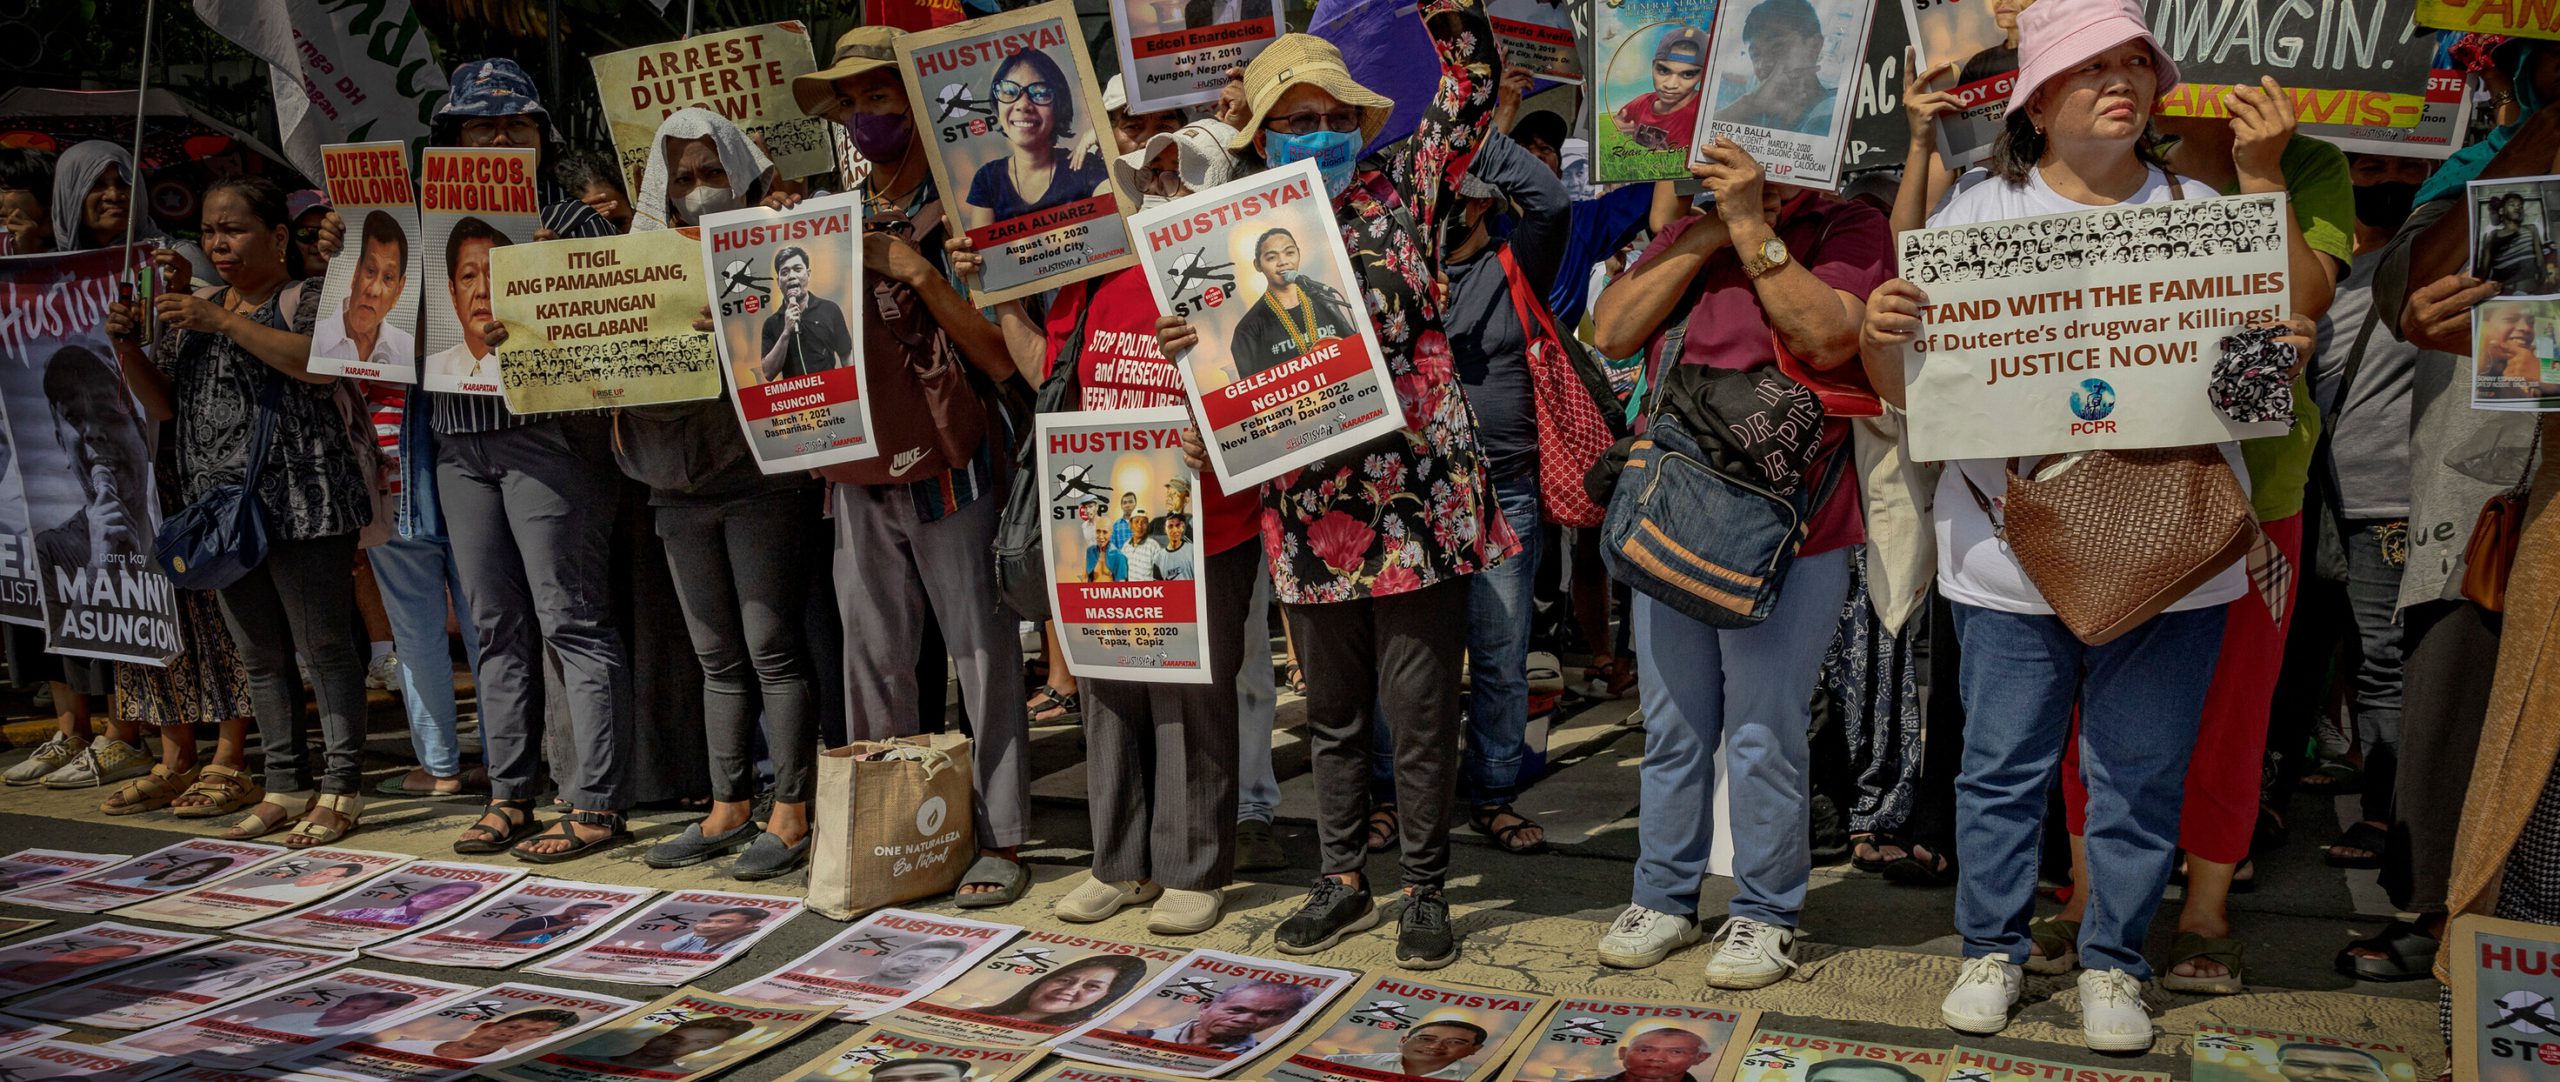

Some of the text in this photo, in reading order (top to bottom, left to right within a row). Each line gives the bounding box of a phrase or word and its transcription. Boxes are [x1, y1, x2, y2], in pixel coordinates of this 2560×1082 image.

[916, 24, 1065, 77] HUSTISYA!
[1146, 24, 1264, 52] Edcel Enardecido
[637, 34, 764, 81] ARREST
[1175, 47, 1242, 66] July 27, 2019
[631, 61, 785, 110] DUTERTE
[1146, 63, 1233, 84] Ayungon, Negros
[335, 76, 368, 107] DH
[1712, 121, 1733, 132] RICO
[1744, 127, 1772, 138] BALLA
[2406, 135, 2448, 144] KARAPATAN
[1767, 148, 1791, 159] BAGONG
[1768, 140, 1788, 149] MARCH
[1798, 144, 1811, 152] 2020
[427, 157, 532, 188] MARCOS,
[1775, 163, 1793, 175] UP
[1794, 161, 1826, 172] CALOOCAN
[329, 176, 414, 205] IKULONG!
[424, 183, 537, 212] SINGILIN!
[987, 202, 1097, 242] ZARA ALVAREZ
[1149, 179, 1311, 253] HUSTISYA!
[713, 213, 850, 252] HUSTISYA!
[1005, 225, 1089, 256] August 17, 2020
[568, 249, 621, 269] ITIGIL
[1019, 241, 1085, 266] Bacolod City
[506, 263, 687, 297] ANG PAMAMASLANG,
[536, 293, 656, 320] KATARUNGAN
[2007, 289, 2082, 317] WITH
[2089, 284, 2142, 308] THE
[2149, 272, 2284, 303] FAMILIES
[547, 316, 649, 341] IPAGLABAN!
[1089, 329, 1116, 352] STOP
[1914, 334, 1937, 353] of
[2064, 317, 2170, 341] drugwar
[2178, 304, 2280, 330] Killings!
[345, 366, 380, 378] KARAPATAN
[1095, 358, 1116, 383] and
[1224, 344, 1341, 400] GELEJURAINE
[1987, 341, 2198, 385] JUSTICE NOW!
[463, 383, 498, 393] KARAPATAN
[613, 388, 625, 397] UP
[764, 375, 825, 396] EMMANUEL
[1251, 372, 1327, 413] NGUJO II
[771, 392, 825, 413] ASUNCION
[1240, 382, 1350, 432] February 23, 2022
[771, 408, 831, 427] March 7, 2021
[817, 416, 846, 428] Cavite
[1221, 437, 1248, 452] New
[1250, 419, 1297, 441] Bataan,
[1299, 401, 1337, 422] Davao
[1340, 392, 1355, 405] de
[1358, 385, 1378, 398] oro
[1342, 408, 1383, 430] KARAPATAN
[2071, 420, 2117, 436] PCPR
[1050, 427, 1189, 454] HUSTISYA
[894, 446, 920, 467] NIKE
[54, 565, 170, 616] MANNY
[1080, 586, 1164, 599] TUMANDOK
[1085, 607, 1164, 619] MASSACRE
[61, 609, 178, 652] ASUNCION
[1082, 627, 1178, 638] December 30, 2020
[1098, 637, 1164, 648] Tapaz, Capiz
[874, 831, 961, 856] ONE NATURALEZA
[303, 850, 398, 865] HUSTISYA!
[893, 848, 949, 877] Be Natural
[402, 865, 511, 883] HUSTISYA!
[518, 885, 636, 903] HUSTISYA!
[672, 893, 799, 909] HUSTISYA!
[873, 915, 1001, 939] HUSTISYA!
[1029, 931, 1185, 962] HUSTISYA!
[327, 973, 458, 998] HUSTISYA!
[780, 973, 905, 997] RAMON PESADILLA
[1191, 958, 1335, 988] HUSTISYA!
[490, 988, 622, 1014] HUSTISYA!
[1375, 979, 1533, 1012] HUSTISYA!
[675, 998, 815, 1022] HUSTISYA!
[922, 1015, 963, 1026] August
[1564, 1001, 1736, 1022] HUSTISYA!
[869, 1034, 1027, 1063] HUSTISYA!
[1109, 1043, 1141, 1051] March
[1758, 1033, 1946, 1065] HUSTISYA!
[2200, 1024, 2406, 1053] HUSTISYA!
[1331, 1065, 1392, 1080] Anthony
